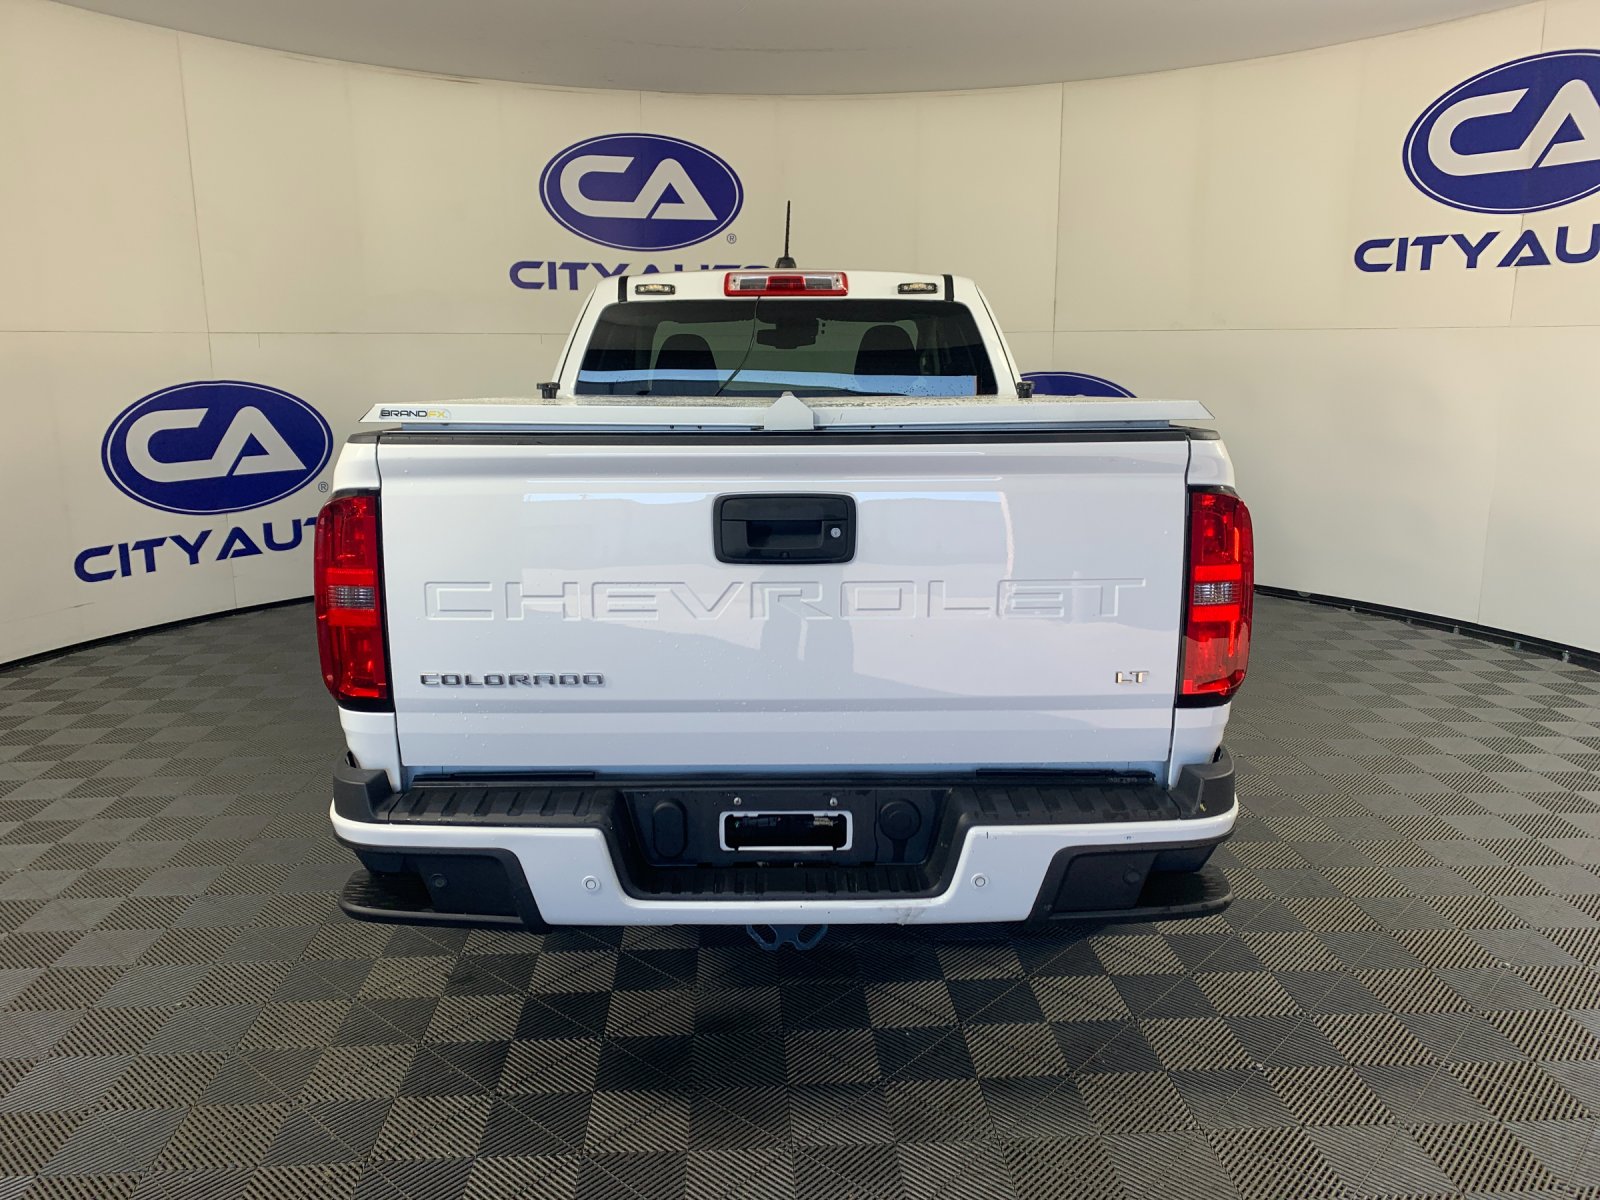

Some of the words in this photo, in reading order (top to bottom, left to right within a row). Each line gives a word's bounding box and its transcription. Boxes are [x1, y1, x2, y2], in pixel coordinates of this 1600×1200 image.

[1428, 79, 1600, 176] CA
[560, 154, 718, 221] CA
[126, 405, 307, 483] CA
[215, 516, 318, 561] AU
[424, 578, 1146, 620] CHEVROLET
[420, 672, 605, 687] COLORADO
[1115, 671, 1149, 684] LT
